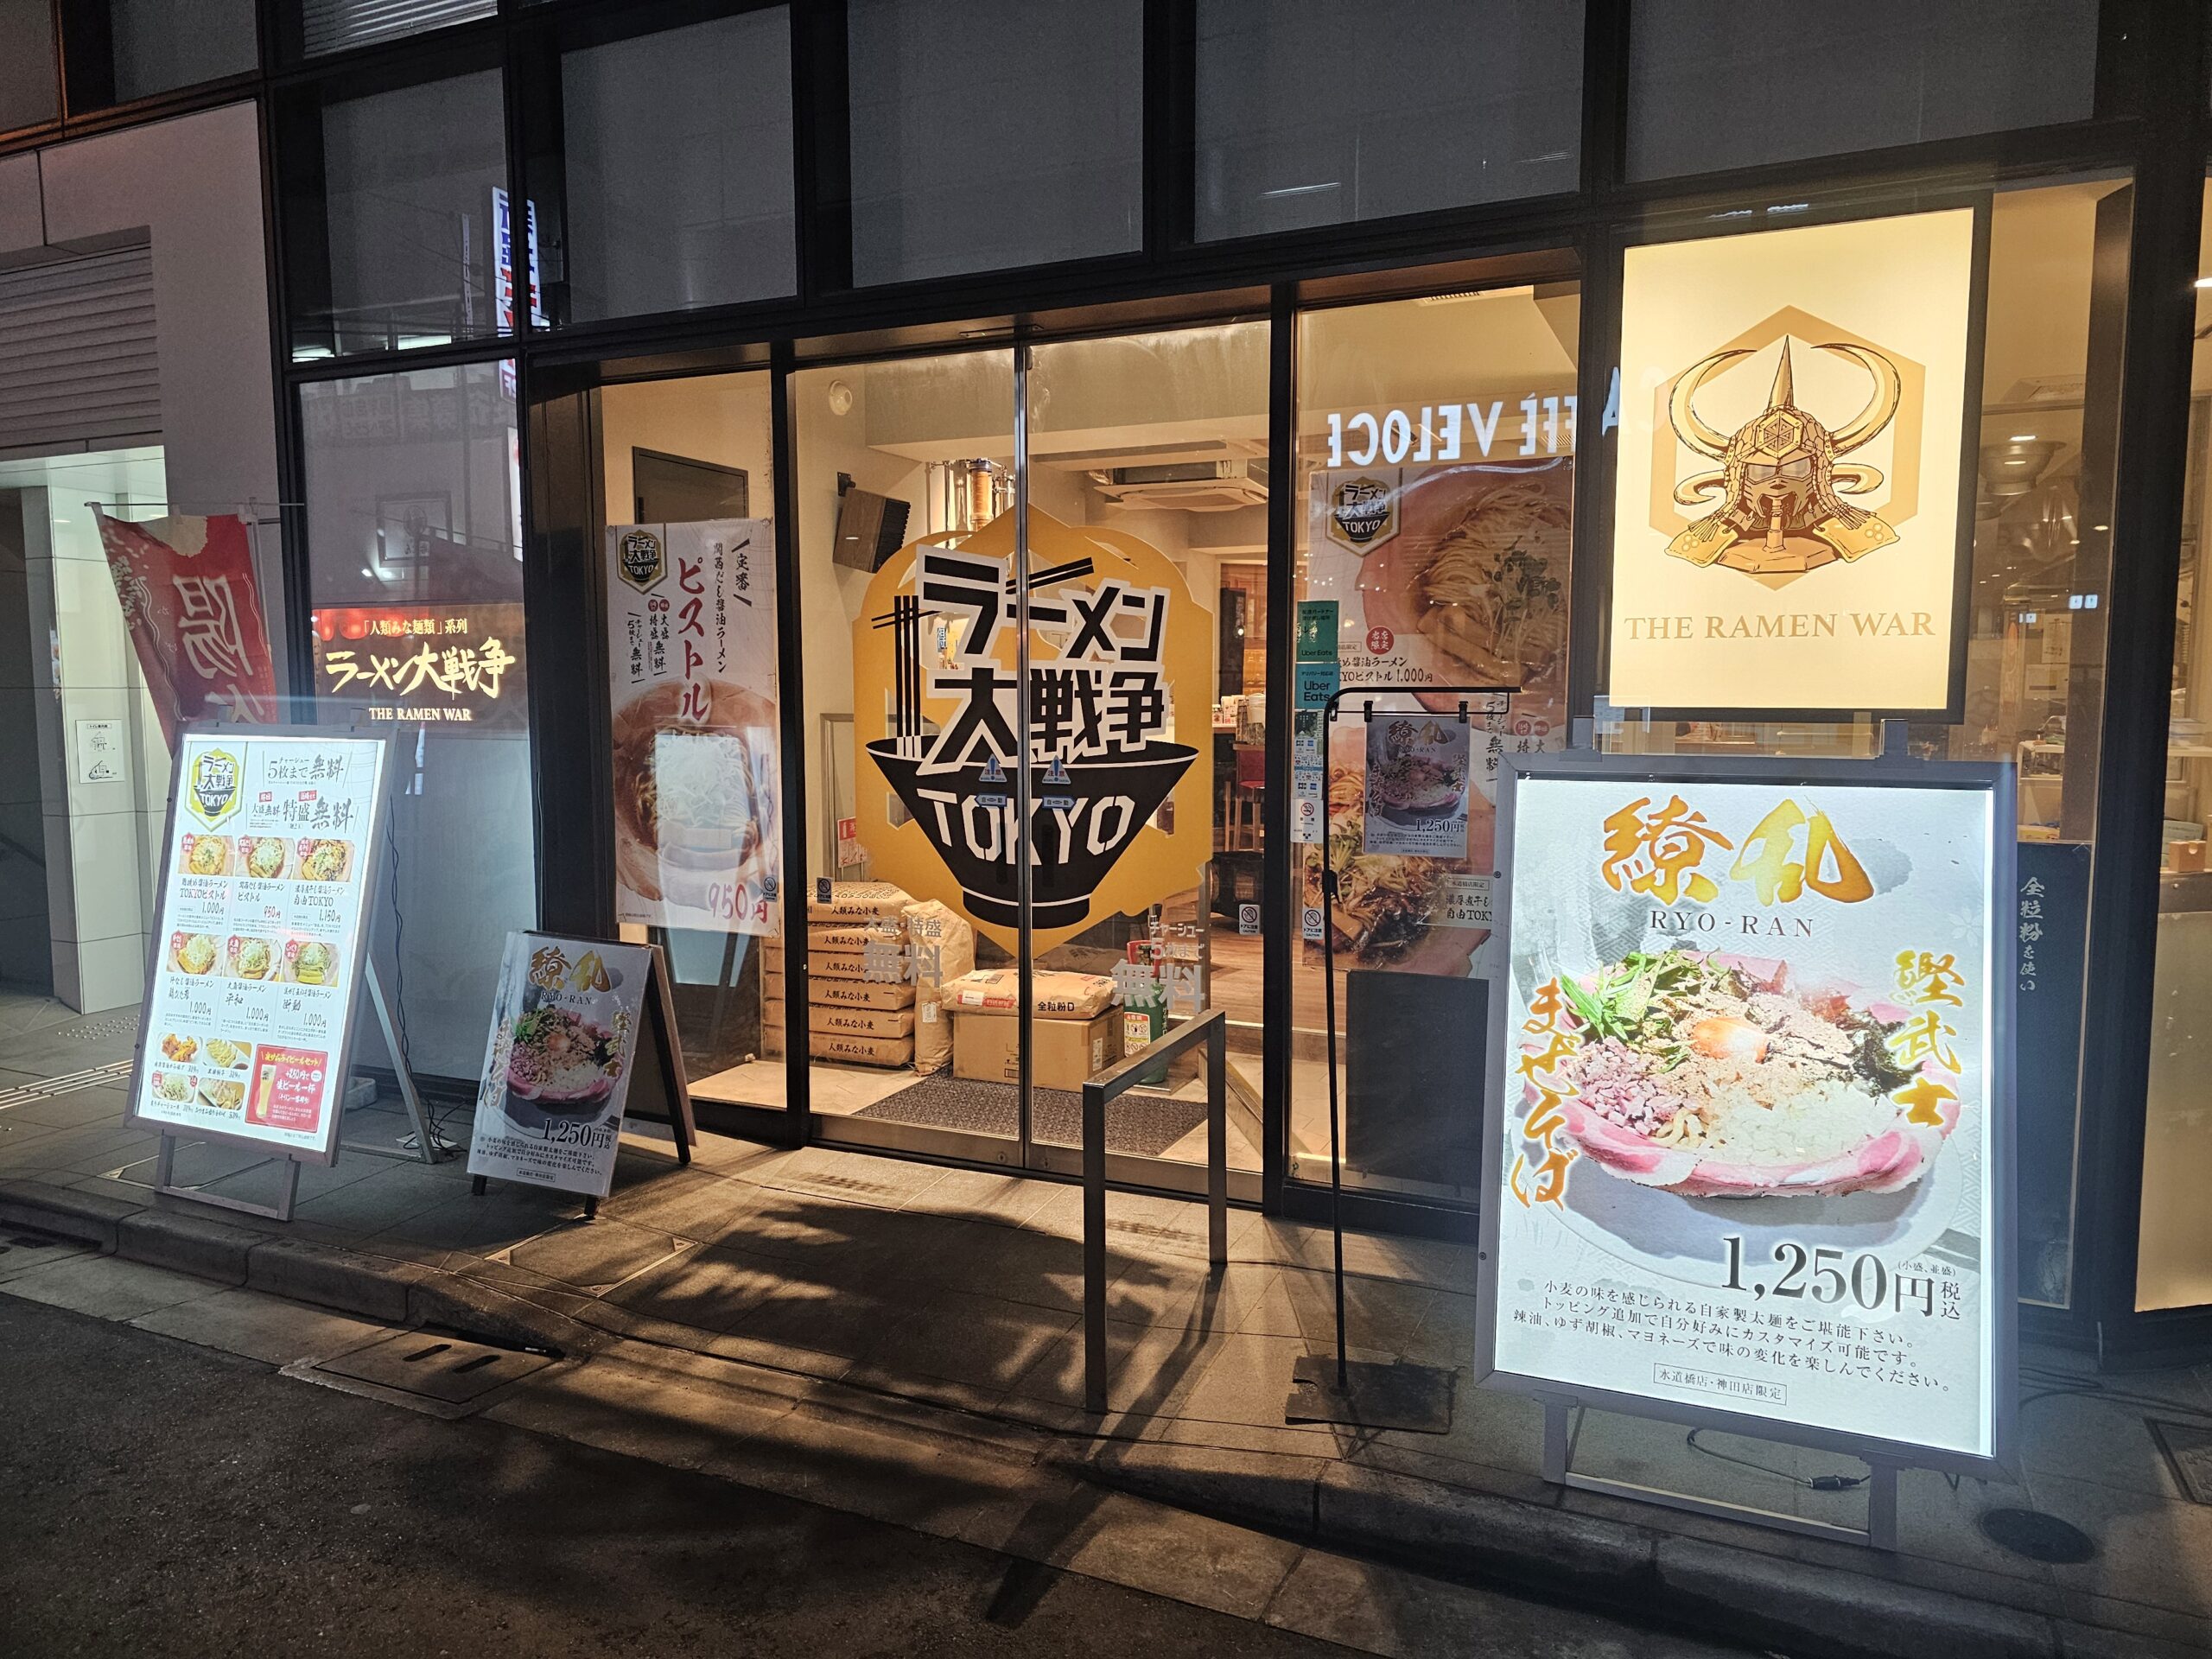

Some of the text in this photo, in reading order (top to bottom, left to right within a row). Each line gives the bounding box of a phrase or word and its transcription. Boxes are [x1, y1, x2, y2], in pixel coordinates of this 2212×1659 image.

[1342, 520, 1381, 533] TOKYO
[627, 536, 656, 549] ラーメン
[630, 550, 657, 563] 大戦争
[629, 565, 654, 575] TOKYO
[735, 553, 750, 591] 定番
[714, 542, 727, 673] 関西だし醤油ラーメン
[923, 555, 1166, 662] ラーメン
[364, 618, 468, 636] 「人類みな麺類」系列
[660, 613, 670, 639] 大盛
[677, 556, 709, 719] ピストル
[1624, 611, 1936, 640] THE RAMEN WAR
[326, 636, 516, 701] ラーメン大戦争
[630, 646, 644, 677] 無料
[653, 640, 666, 671] 無料
[1304, 680, 1331, 690] Uber
[1304, 691, 1331, 702] Eats
[369, 708, 474, 721] THE RAMEN WAR
[931, 667, 1165, 766] 大戦争
[203, 755, 234, 772] ラーメン
[268, 760, 310, 779] 5枚まで
[309, 753, 346, 783] 無料
[203, 774, 233, 788] 大戦争
[200, 792, 230, 807] TOKYO
[283, 799, 310, 823] 特盛
[309, 796, 354, 835] 無料
[916, 787, 1135, 865] TOKYO
[1416, 819, 1460, 834] 1,250円
[1603, 794, 1876, 906] 繚乱
[831, 906, 880, 916] 人類みな小麦
[1446, 893, 1492, 907] 濃厚煮干し
[1148, 922, 1205, 938] チャーシュー
[1649, 909, 1815, 938] RYO-RAN
[2019, 876, 2045, 991] 全粒粉を使い
[529, 946, 611, 993] 繚乱
[864, 940, 943, 988] 無料
[824, 990, 871, 1002] 人類みな小麦
[1109, 958, 1205, 1014] 無料
[1037, 1001, 1075, 1012] 全粒粉D
[827, 1017, 874, 1030] 人類みな小麦
[829, 1043, 875, 1056] 人類みな小麦
[1510, 976, 1581, 1211] まぜそば
[541, 1118, 605, 1150] 1,250円
[1721, 1236, 1935, 1319] 1,250円
[1543, 1280, 1915, 1350] 小麦の味を感じられる自家製太麺をご堪能下さい。
[1940, 1281, 1961, 1320] 税込
[1541, 1297, 1917, 1368] トッピング追加で自分好みにカスタマイズ可能です。
